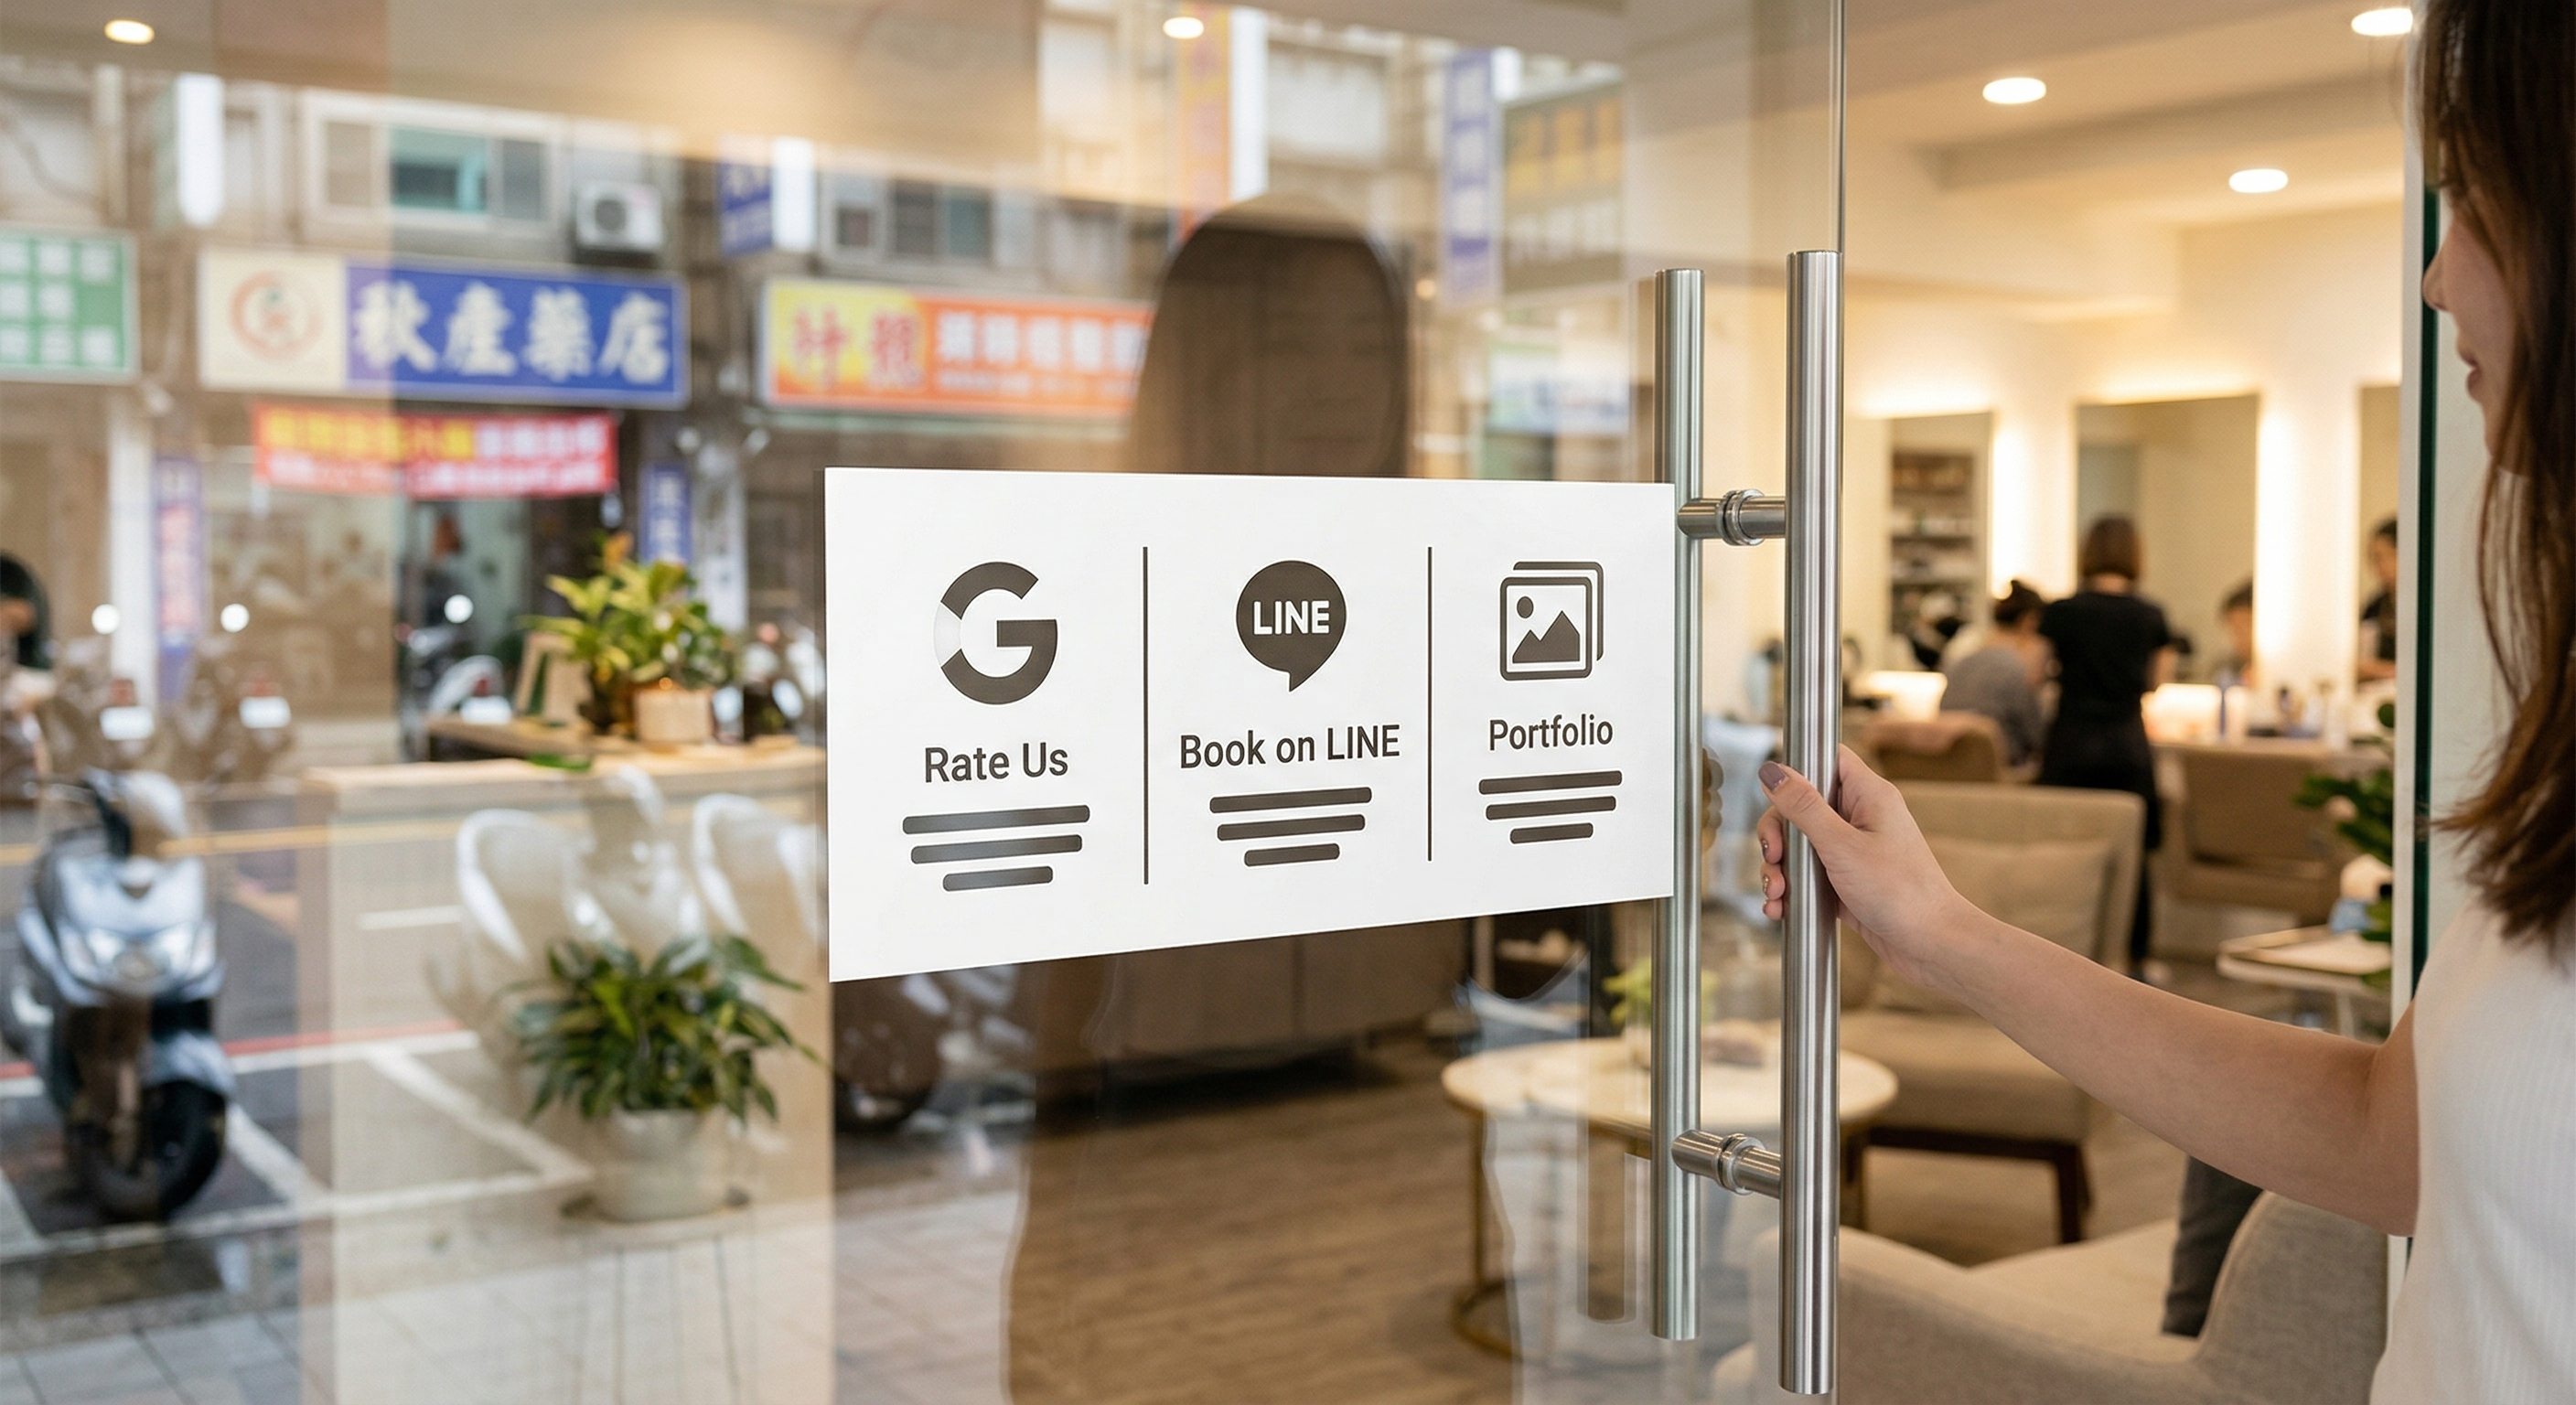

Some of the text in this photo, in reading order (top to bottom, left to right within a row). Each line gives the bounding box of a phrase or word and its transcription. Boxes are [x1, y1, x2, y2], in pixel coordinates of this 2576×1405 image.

[934, 560, 1058, 705] G
[1253, 600, 1330, 635] LINE
[1180, 724, 1401, 769] Book on LINE
[1489, 713, 1614, 751] Portfolio
[925, 742, 1068, 783] Rate Us
